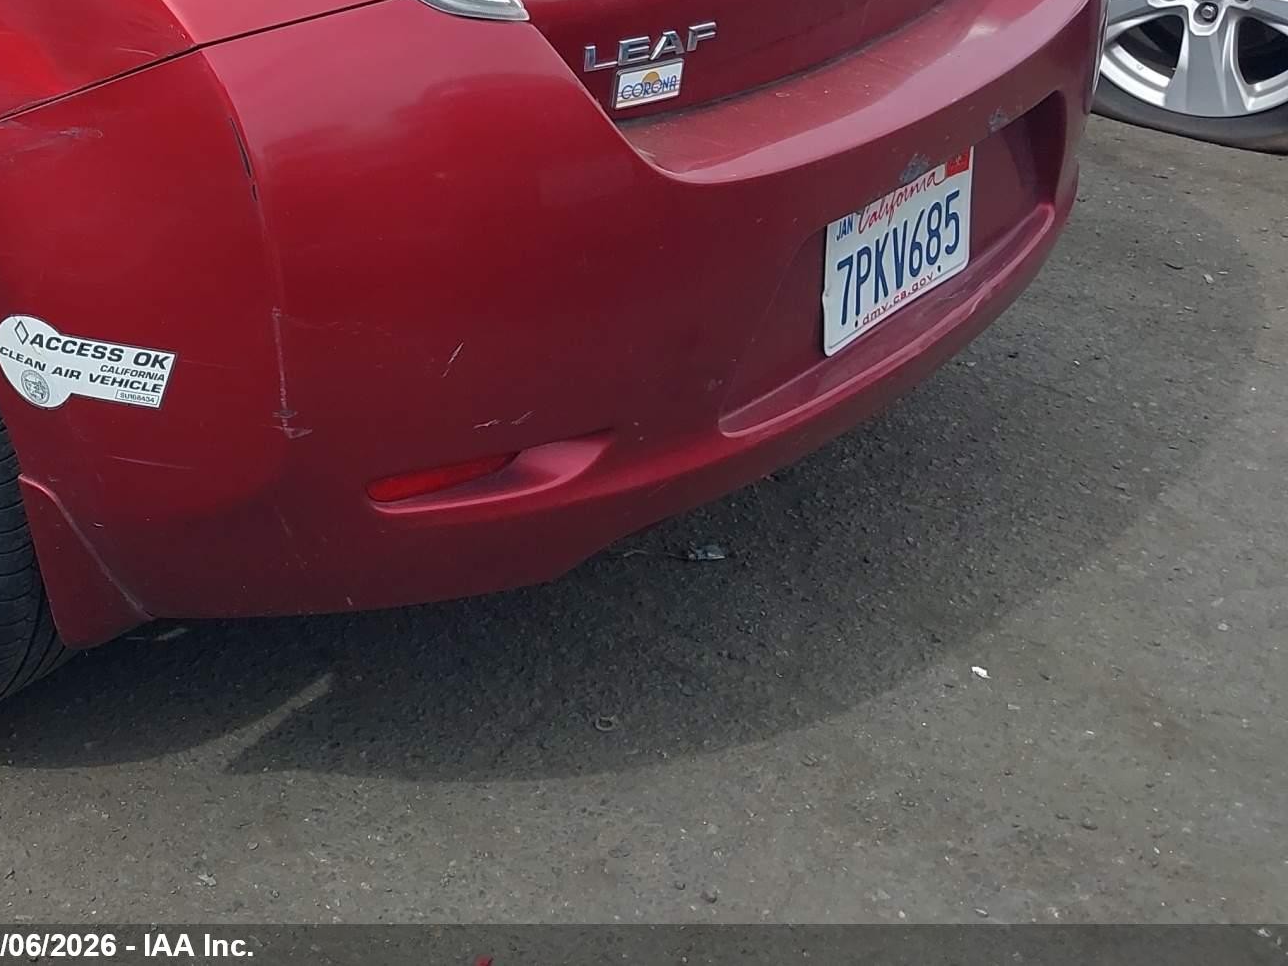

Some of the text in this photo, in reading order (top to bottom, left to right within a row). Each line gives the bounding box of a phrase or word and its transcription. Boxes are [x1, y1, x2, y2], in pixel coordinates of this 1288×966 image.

[583, 20, 718, 73] LEAF
[620, 73, 678, 100] CORONA
[835, 171, 946, 242] JAN California
[836, 189, 961, 326] 7PKV685
[861, 271, 935, 327] dmv.ca.gov
[0, 345, 164, 394] CLEAN AIR VEHICLE
[29, 332, 171, 370] ACCESS OK
[99, 364, 166, 382] CALIFORNIA
